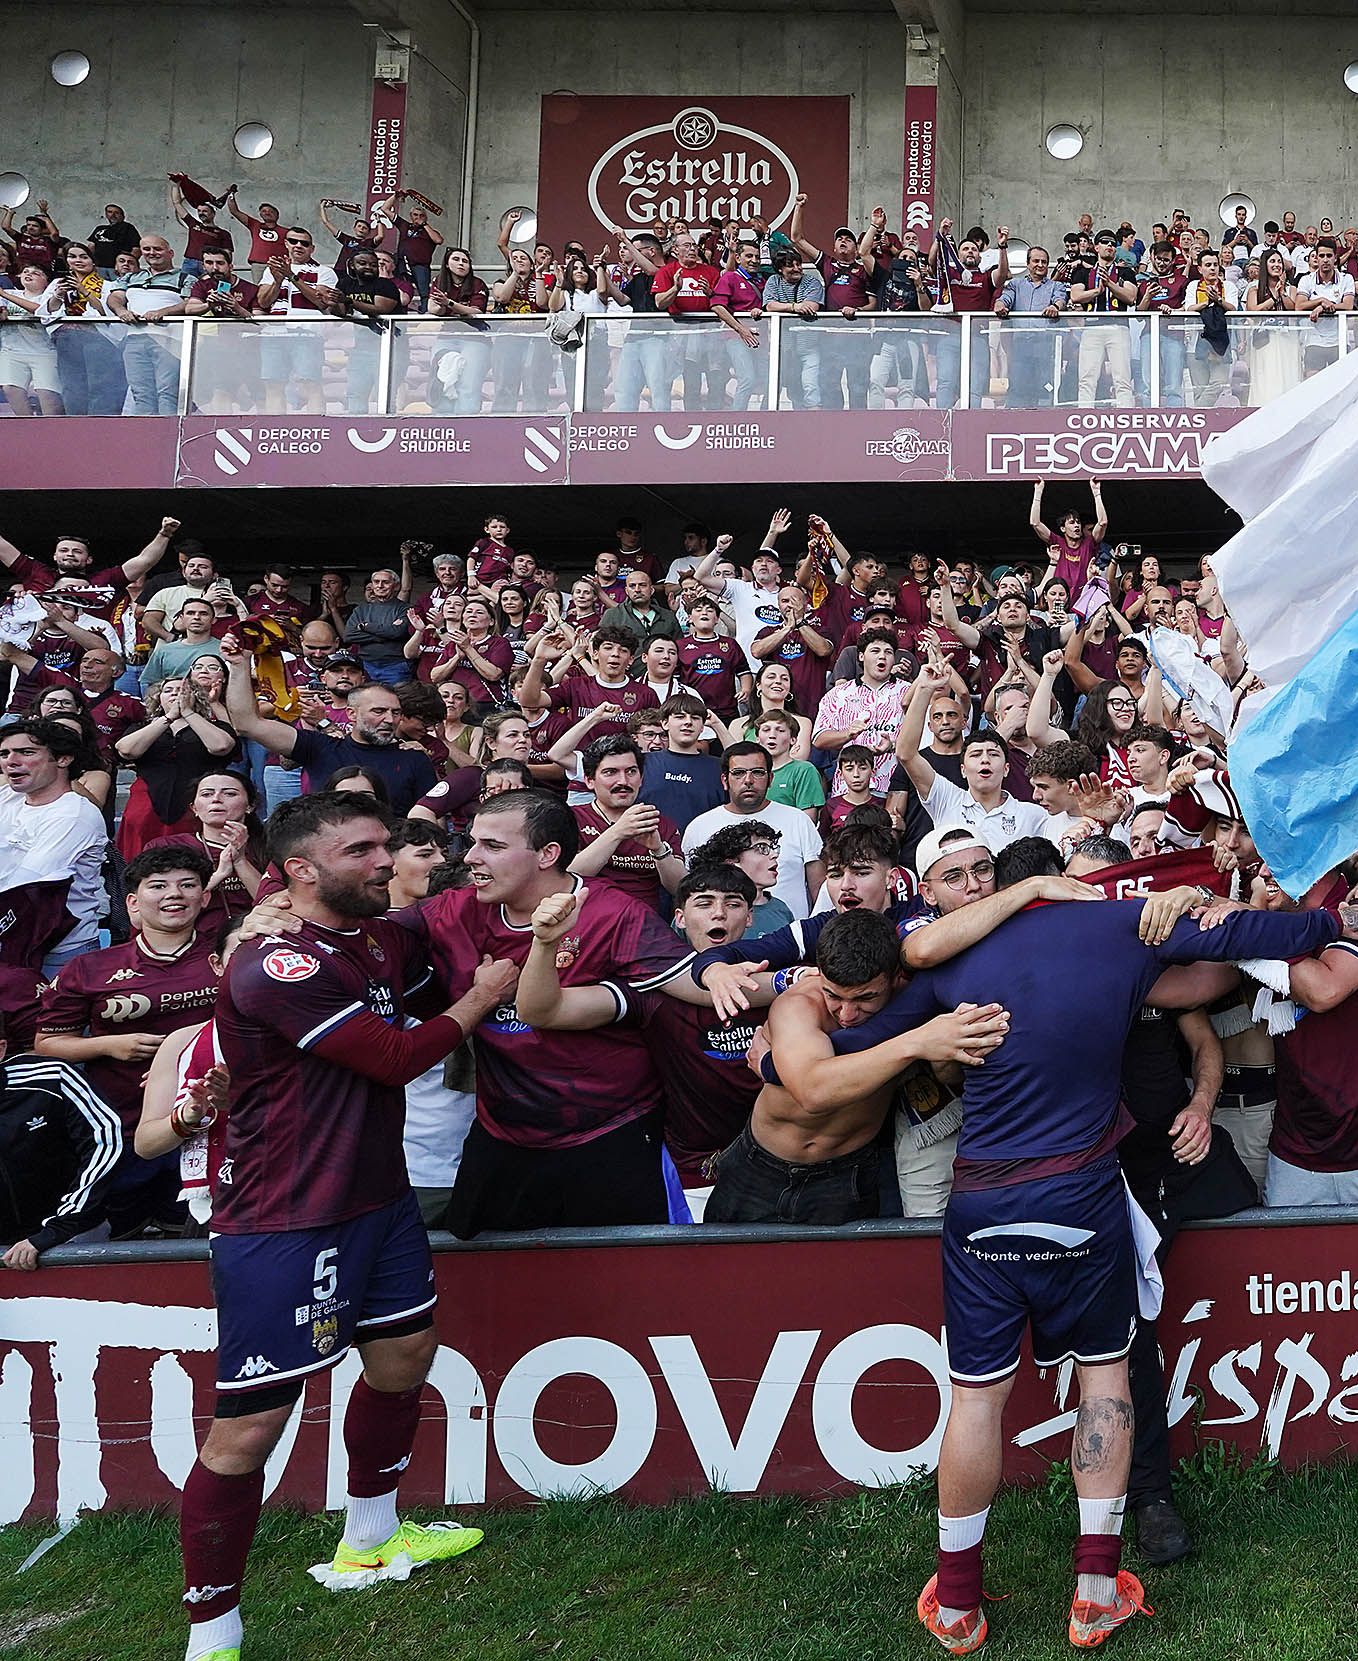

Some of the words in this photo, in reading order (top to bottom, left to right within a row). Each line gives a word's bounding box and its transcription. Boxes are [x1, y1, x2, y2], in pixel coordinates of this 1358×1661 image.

[371, 119, 388, 194] Deputación
[385, 118, 400, 194] Pontevedra
[906, 120, 921, 195] Deputación
[919, 121, 933, 195] Pontevedra
[618, 150, 772, 187] Estrella
[625, 187, 763, 225] Galicia
[705, 424, 760, 436] GALICIA
[1066, 414, 1207, 430] CONSERVAS
[258, 428, 331, 440] DEPORTE
[400, 428, 455, 440] GALICIA
[568, 425, 638, 438] DEPORTE
[257, 442, 322, 453] GALEGO
[399, 440, 471, 453] SAUDABLE
[568, 438, 629, 451] GALEGO
[705, 436, 775, 449] SAUDABLE
[866, 439, 950, 459] PESCAMAR
[665, 772, 692, 783] Buddy.
[707, 1025, 755, 1043] Estrella
[313, 1247, 339, 1301] 5
[310, 1310, 323, 1320] DE
[323, 1299, 351, 1317] GALICIA
[311, 1297, 338, 1312] XUNTA
